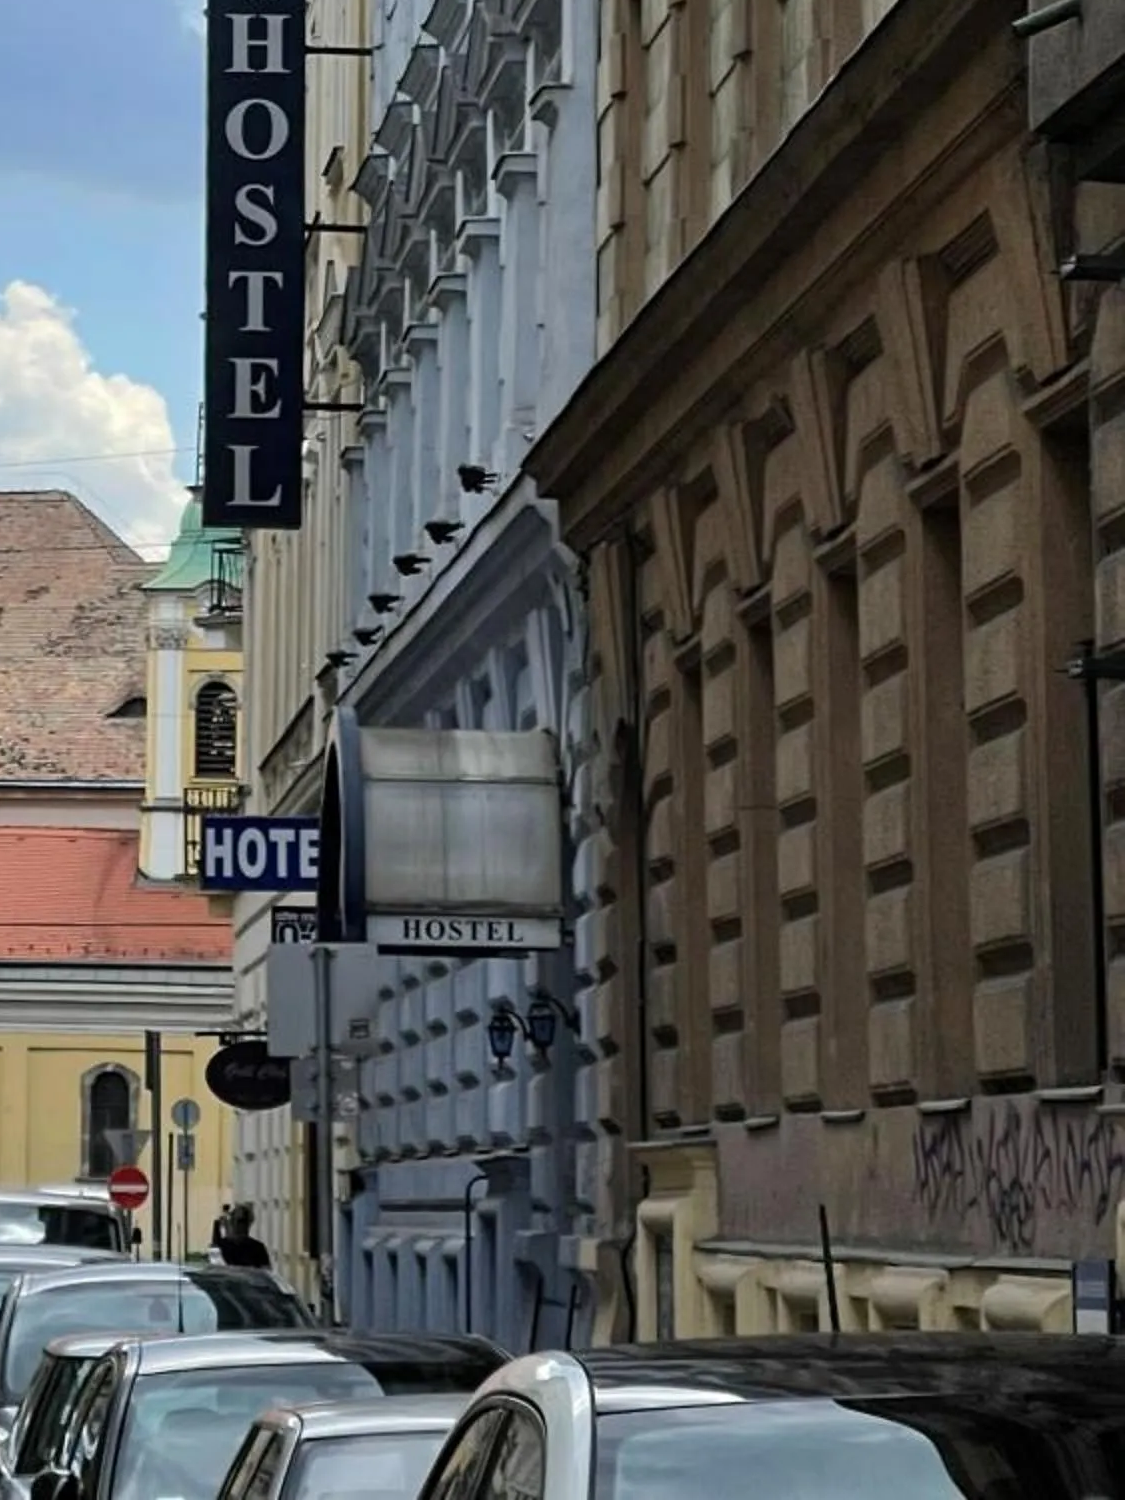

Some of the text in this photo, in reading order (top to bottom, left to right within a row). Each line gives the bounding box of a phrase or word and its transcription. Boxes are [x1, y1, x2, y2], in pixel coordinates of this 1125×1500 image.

[223, 13, 292, 507] HOSTEL
[205, 827, 320, 878] HOTE
[403, 918, 524, 943] HOSTEL
